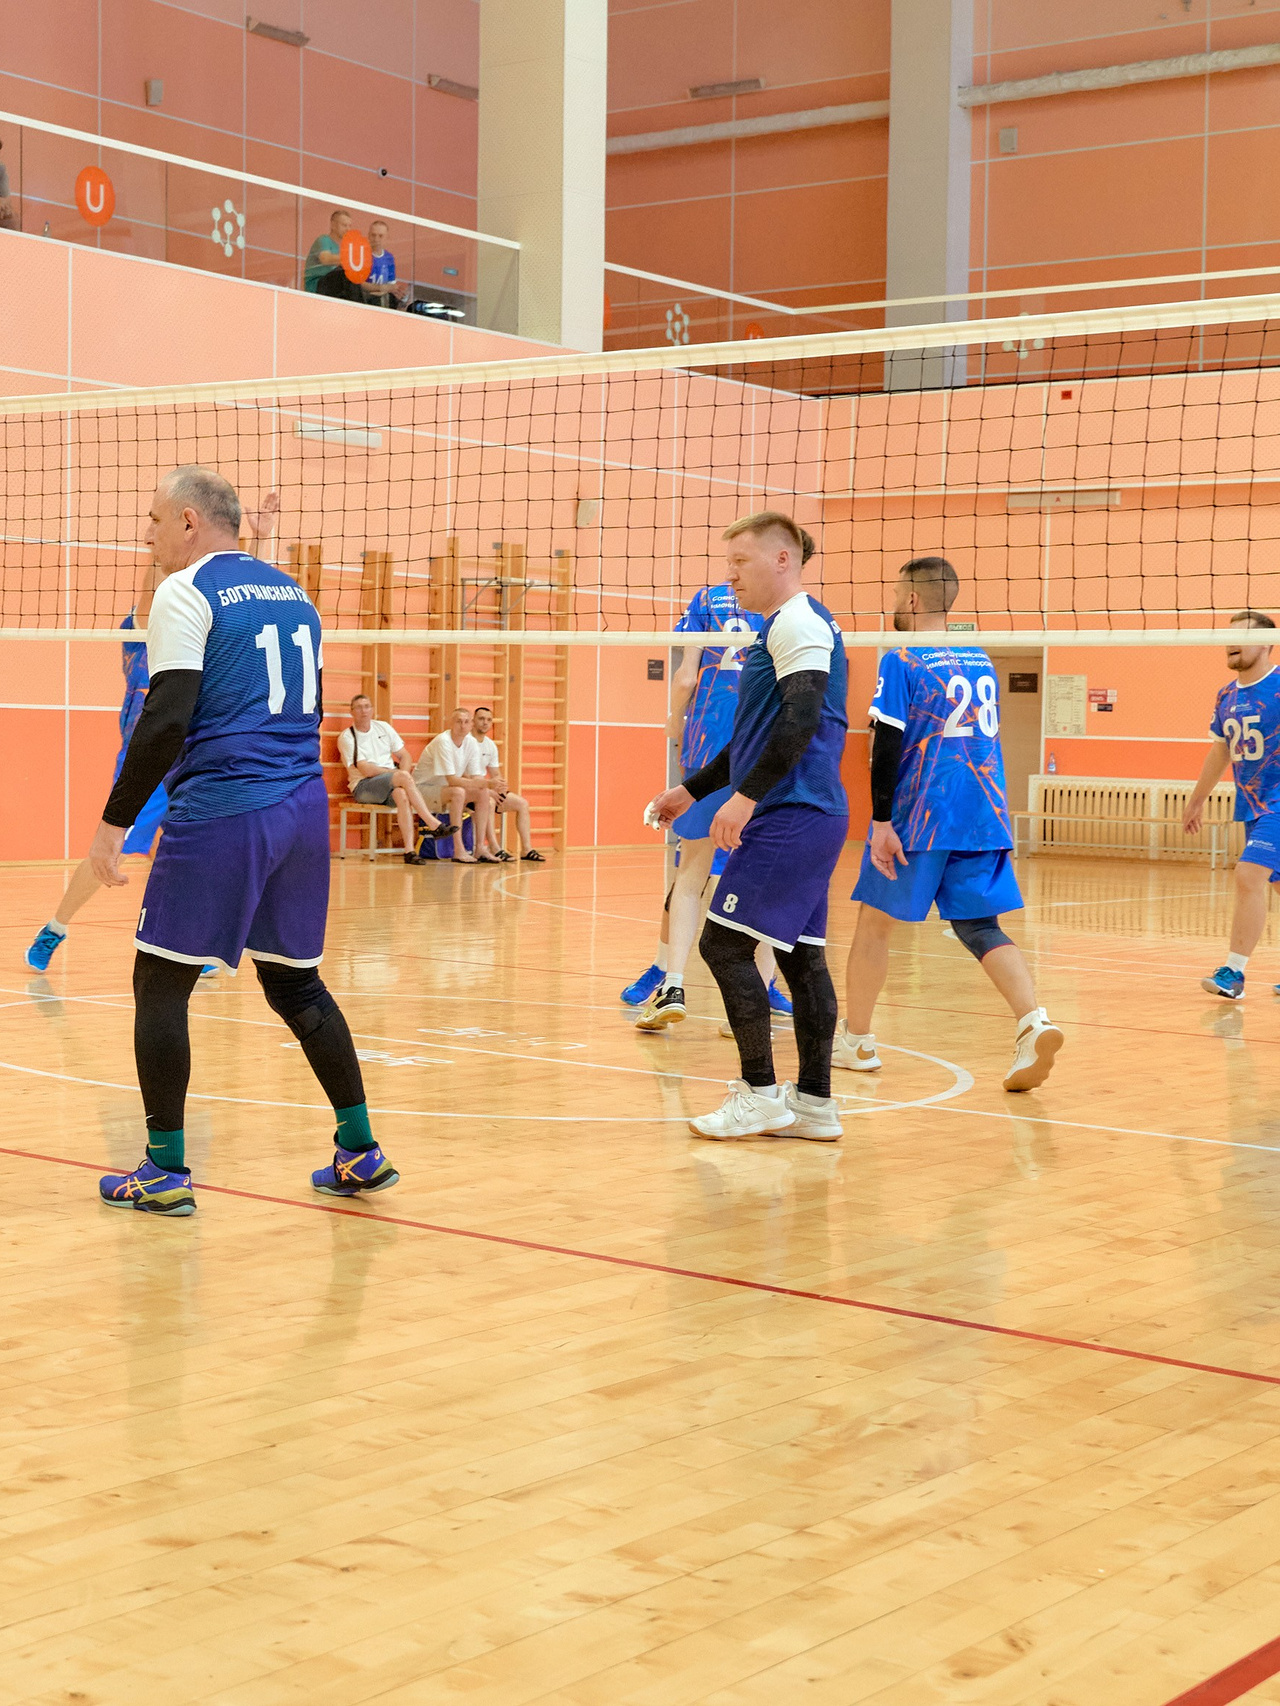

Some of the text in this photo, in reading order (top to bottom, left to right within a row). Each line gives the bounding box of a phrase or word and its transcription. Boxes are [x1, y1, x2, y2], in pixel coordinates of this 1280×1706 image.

[86, 181, 104, 213] U
[349, 243, 364, 272] U
[217, 584, 298, 607] БОГУЧАНСКАЯ
[255, 624, 317, 714] 11
[943, 674, 999, 738] 28
[1222, 715, 1265, 761] 25
[722, 893, 739, 913] 8
